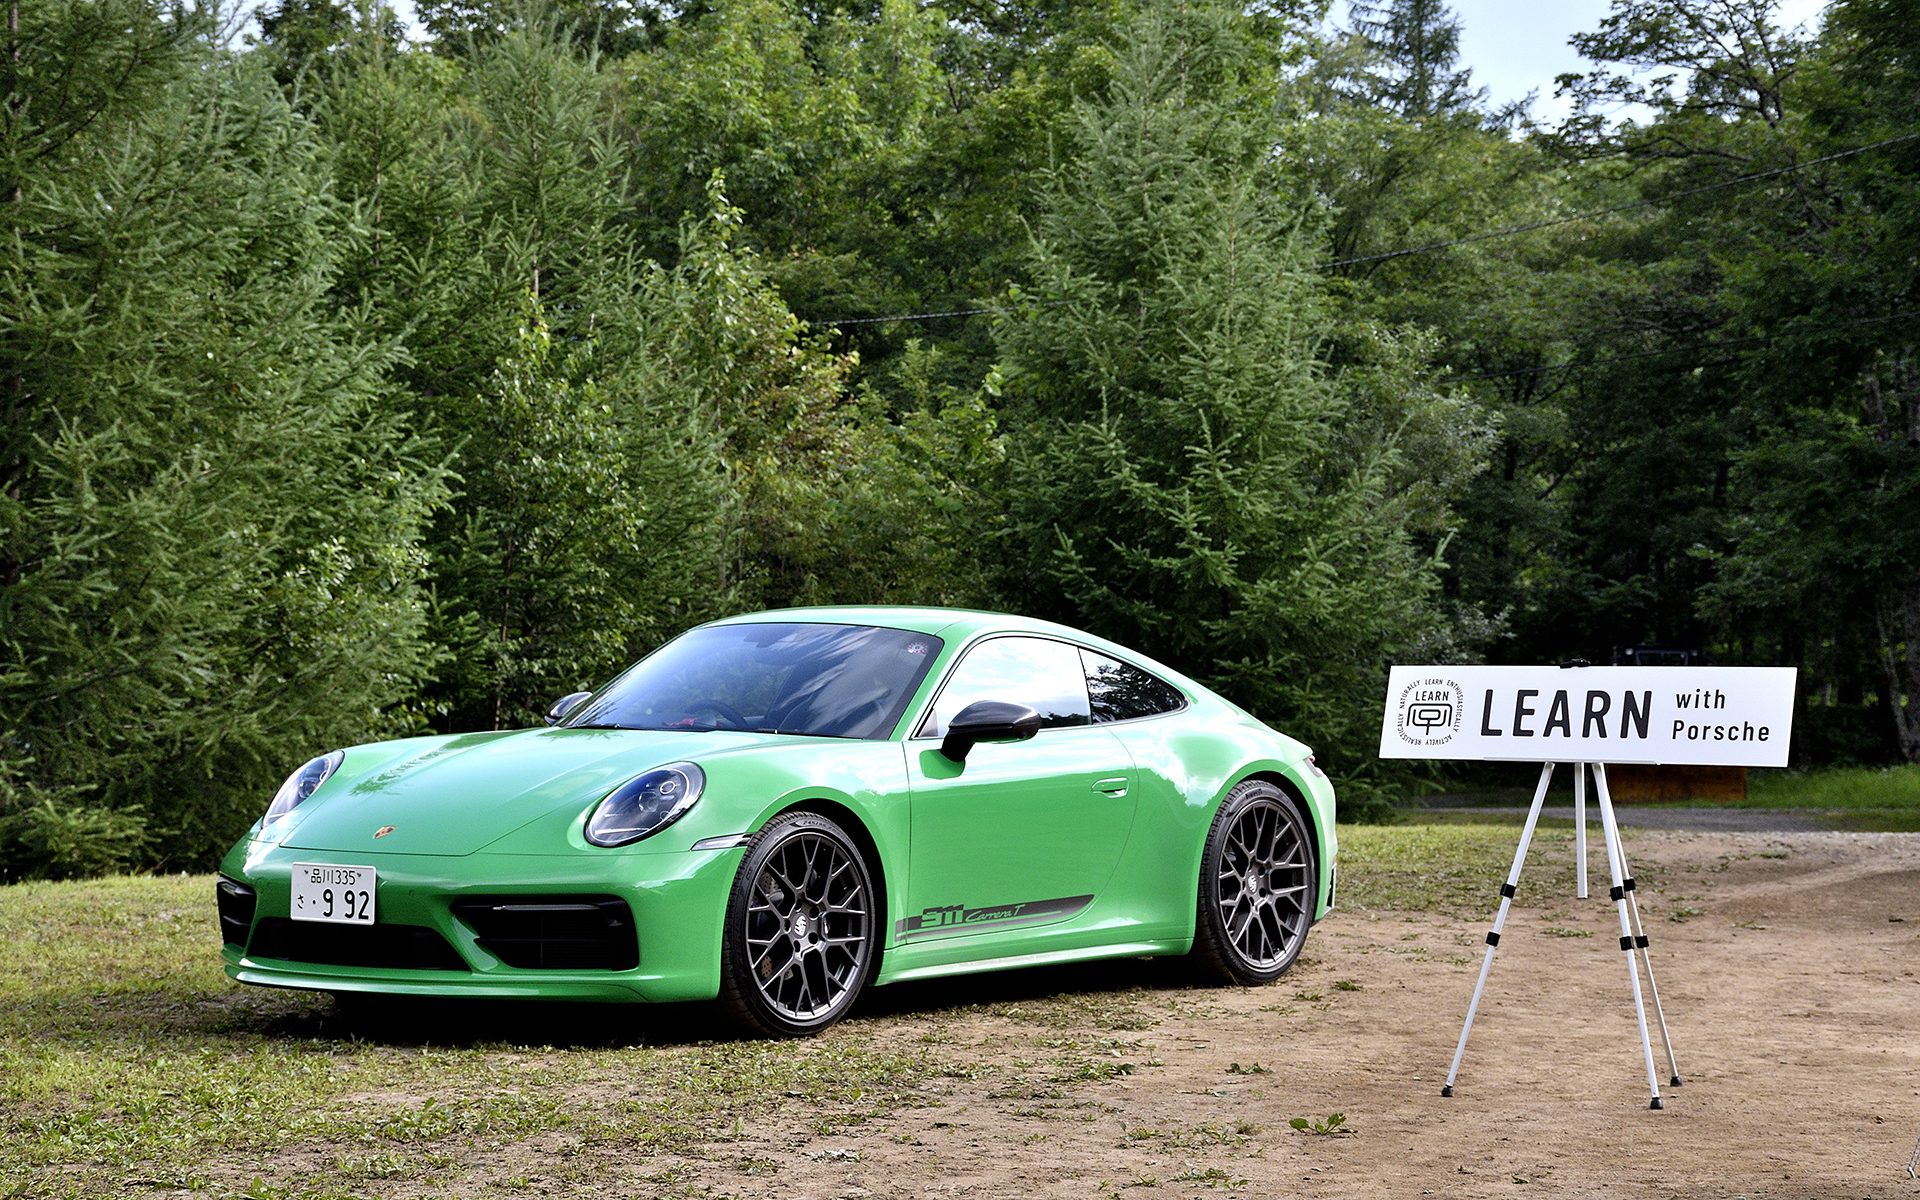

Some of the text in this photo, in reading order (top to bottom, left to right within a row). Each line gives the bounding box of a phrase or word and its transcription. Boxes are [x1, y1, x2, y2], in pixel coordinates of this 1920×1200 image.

[1400, 680, 1420, 709] NATURALLY
[1415, 691, 1449, 701] LEARN
[1446, 680, 1464, 732] ENTHUSIASTICALLY
[1676, 689, 1726, 709] with
[1481, 689, 1653, 739] LEARN
[1397, 713, 1421, 745] REALISTICALLY
[1425, 734, 1452, 745] ACTIVELY
[1672, 719, 1770, 742] Porsche
[297, 894, 304, 909] さ
[921, 904, 1026, 928] 911 Carrera T
